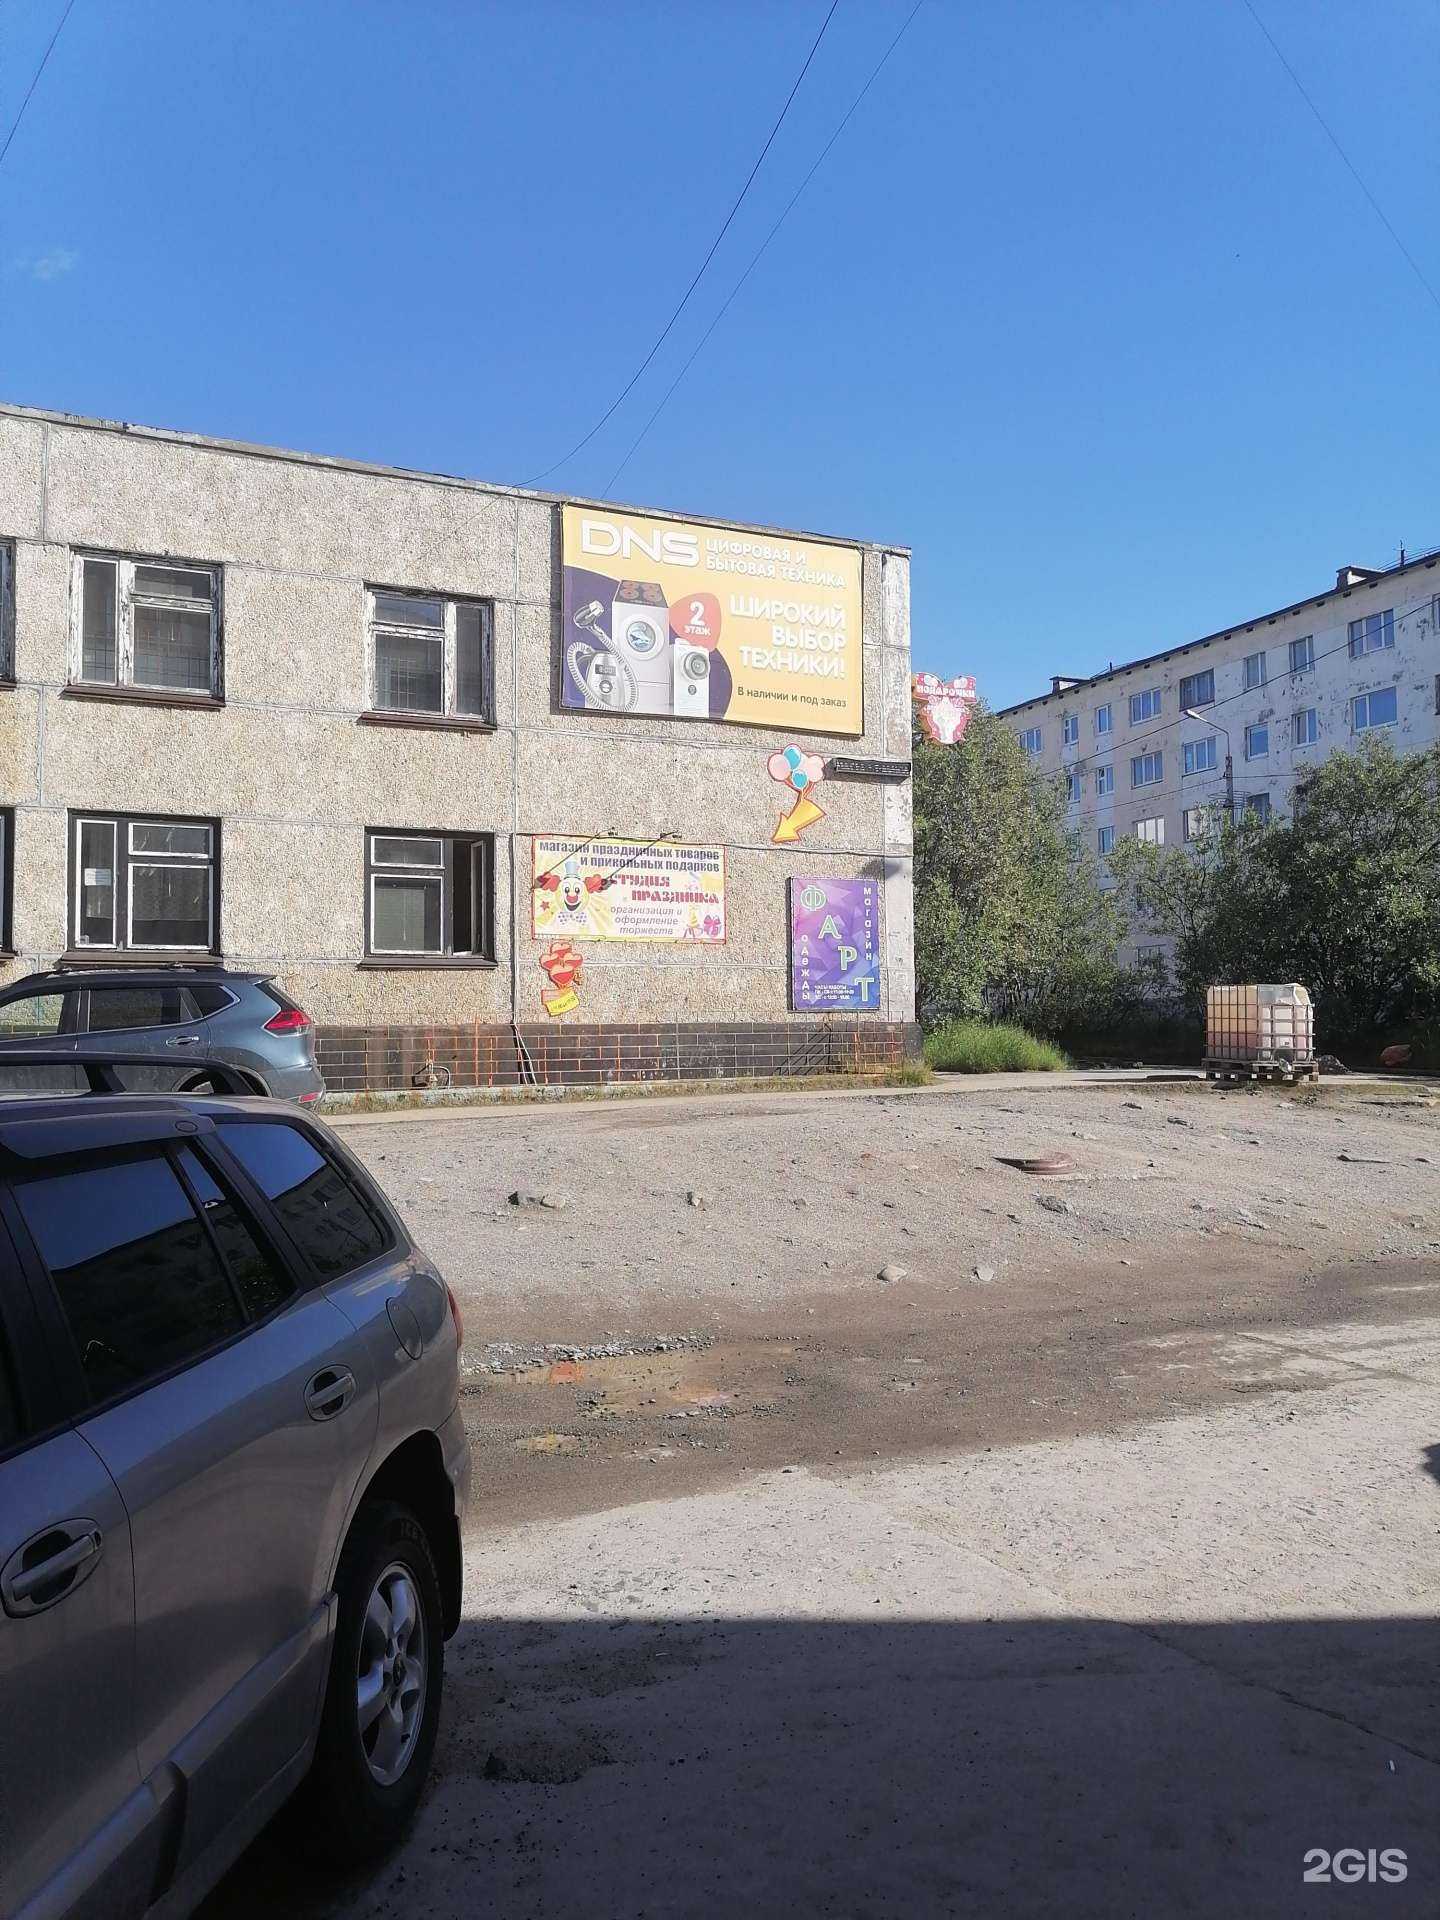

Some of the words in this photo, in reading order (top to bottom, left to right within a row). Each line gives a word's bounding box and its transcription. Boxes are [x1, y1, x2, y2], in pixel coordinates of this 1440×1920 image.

[582, 519, 700, 567] DNS
[705, 539, 791, 562] ЦИФРОВАЯ
[796, 551, 808, 565] И
[706, 554, 776, 579] БЫТОВАЯ
[780, 566, 847, 588] ТЕХНИКА
[689, 601, 705, 625] 2
[730, 594, 846, 631] ШИРОКИЙ
[773, 626, 846, 654] ВЫБОР
[740, 645, 845, 680] ТЕХНИКИ!
[737, 686, 745, 696] В
[747, 689, 789, 701] наличии
[800, 695, 818, 706] под
[820, 697, 847, 708] заказ
[539, 841, 589, 854] магазин
[592, 844, 672, 858] праздничных
[675, 849, 720, 861] товаров
[590, 856, 663, 870] прикольных
[666, 861, 720, 872] подарков
[610, 905, 674, 915] организация
[614, 915, 679, 925] оформление
[619, 926, 673, 935] торжеств
